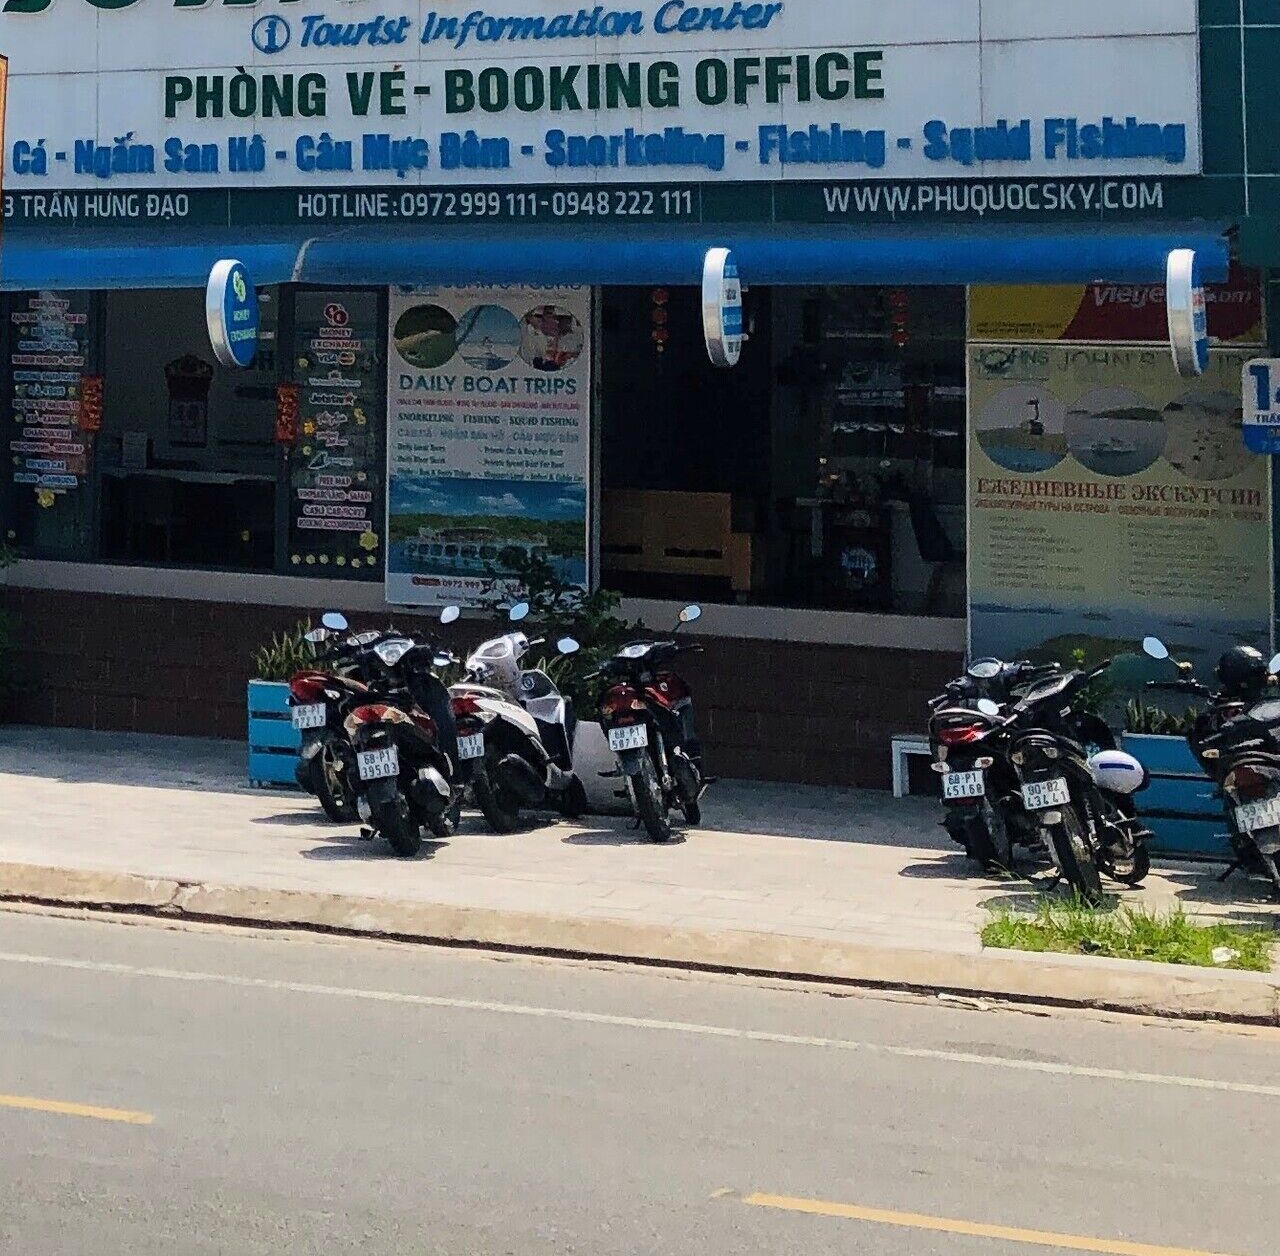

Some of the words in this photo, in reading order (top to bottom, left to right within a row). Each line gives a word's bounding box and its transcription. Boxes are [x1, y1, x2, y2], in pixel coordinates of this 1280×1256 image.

[300, 13, 411, 47] Tourist
[421, 5, 646, 49] Information
[164, 66, 327, 119] PHÒNG
[445, 60, 680, 114] BOOKING
[695, 51, 885, 105] OFFICE
[164, 137, 219, 174] San
[296, 132, 352, 173] Câu
[544, 127, 725, 172] Snorkeling
[758, 123, 886, 169] Fishing
[923, 120, 1031, 166] Squid
[1044, 116, 1185, 164] Fishing
[146, 193, 190, 220] ĐẠO
[823, 181, 1164, 216] WWW.PHUQUOCSKY.COM
[399, 374, 457, 391] DAILY
[463, 376, 518, 394] BOAT
[523, 377, 577, 395] TRIPS
[398, 412, 454, 423] SNORKELING
[463, 415, 500, 425] FISHING
[541, 417, 579, 427] FISHING
[977, 477, 1126, 500] ЕЖЕДНЕВНЫЕ
[1130, 483, 1261, 506] ЭКСКУРСИИ
[364, 750, 391, 765] 68-P1
[948, 772, 976, 785] 68-P1
